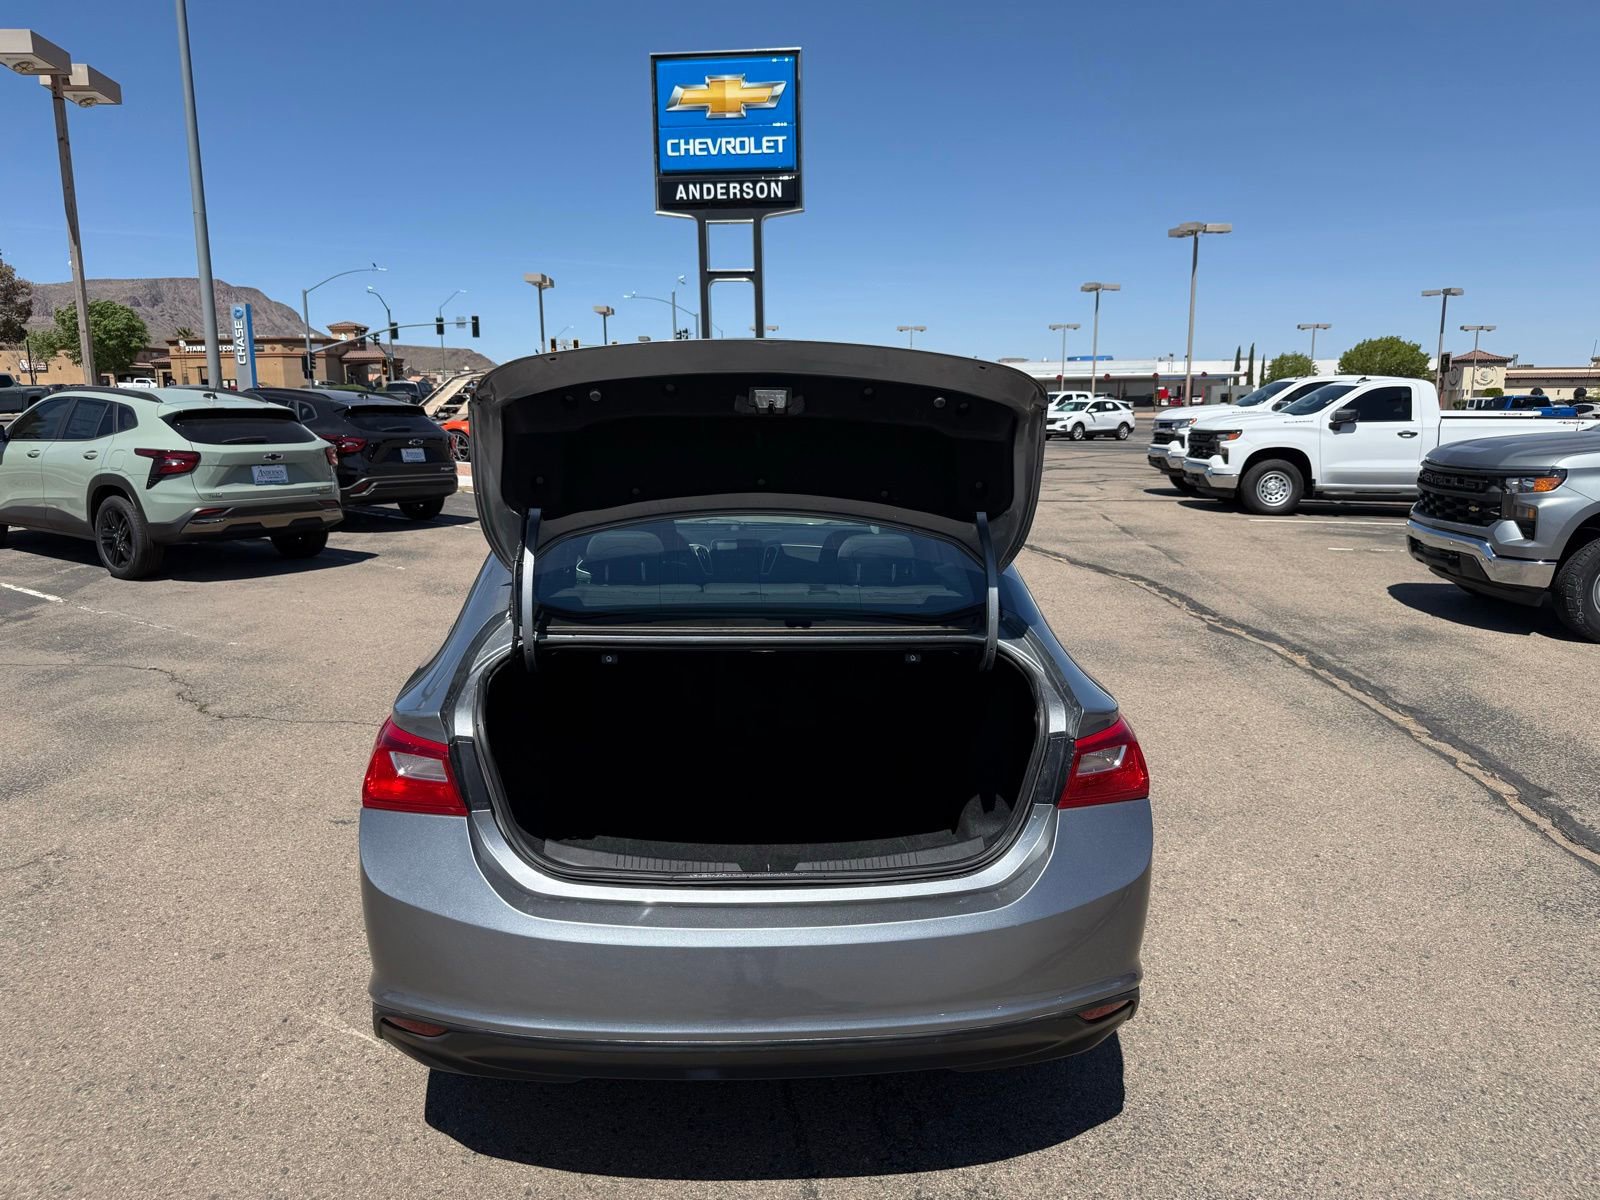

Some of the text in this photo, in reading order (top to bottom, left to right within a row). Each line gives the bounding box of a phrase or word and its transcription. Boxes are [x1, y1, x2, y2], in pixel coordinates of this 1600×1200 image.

[666, 136, 787, 156] CHEVROLET
[675, 181, 782, 201] ANDERSON
[234, 320, 247, 365] CHASE
